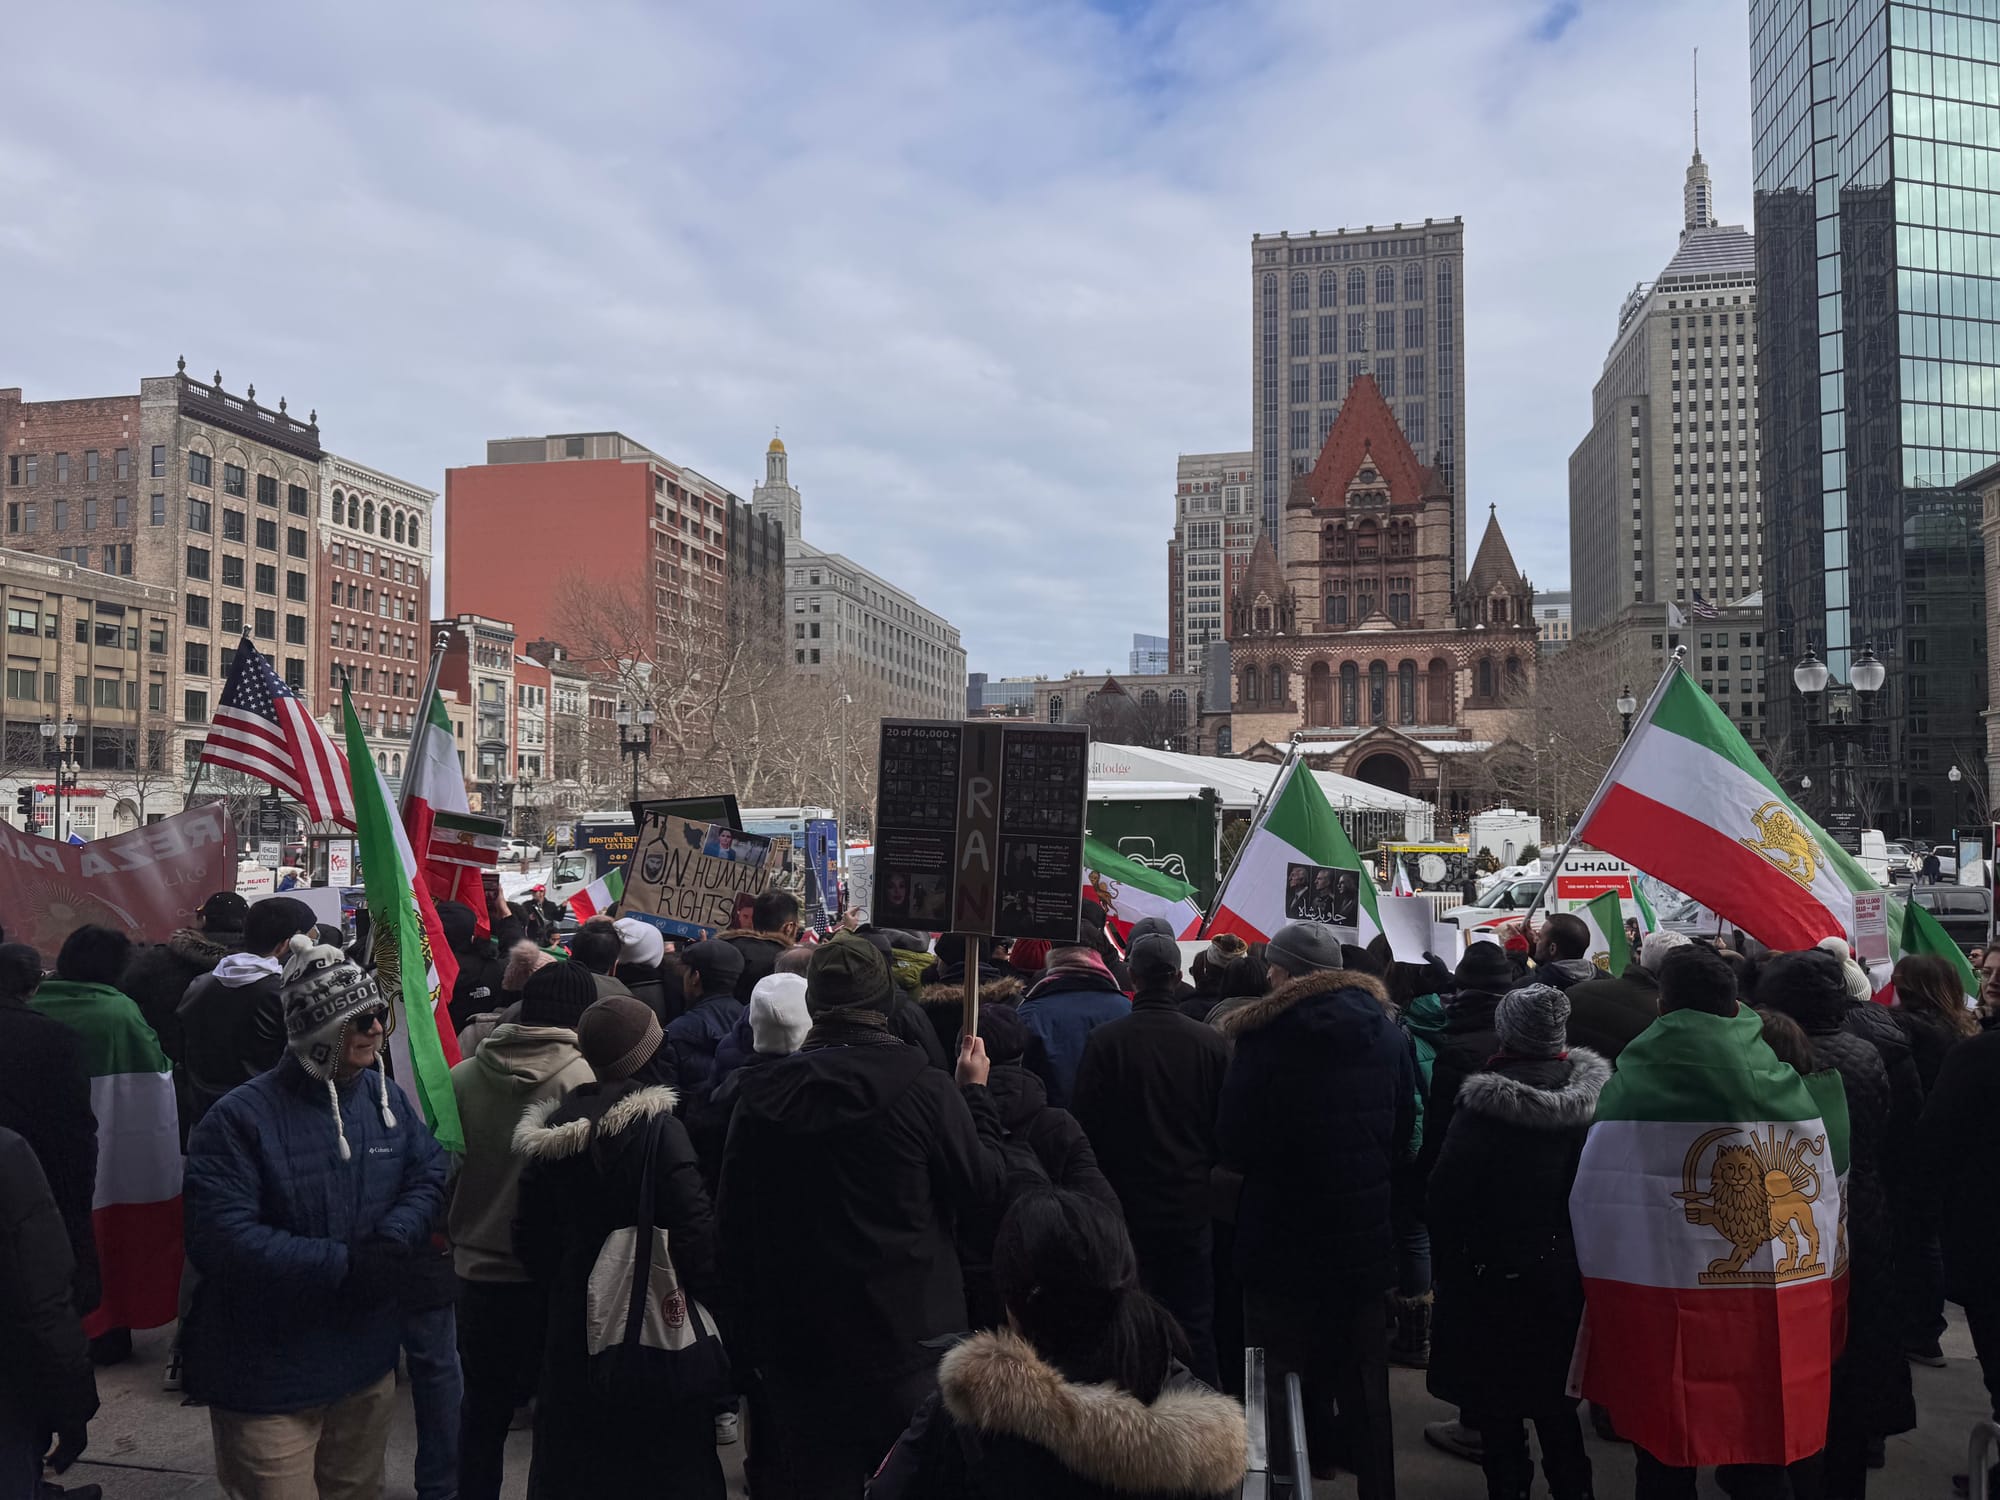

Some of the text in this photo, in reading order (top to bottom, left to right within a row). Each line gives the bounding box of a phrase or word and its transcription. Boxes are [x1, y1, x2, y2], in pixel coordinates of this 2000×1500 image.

[886, 728, 899, 736] 20
[900, 728, 912, 737] of
[957, 729, 994, 921] IRAN
[641, 847, 767, 895] U.N. HUMAN
[1564, 862, 1630, 872] U-HAUL
[657, 886, 735, 927] RIGHTS
[312, 987, 368, 1022] CUSCO
